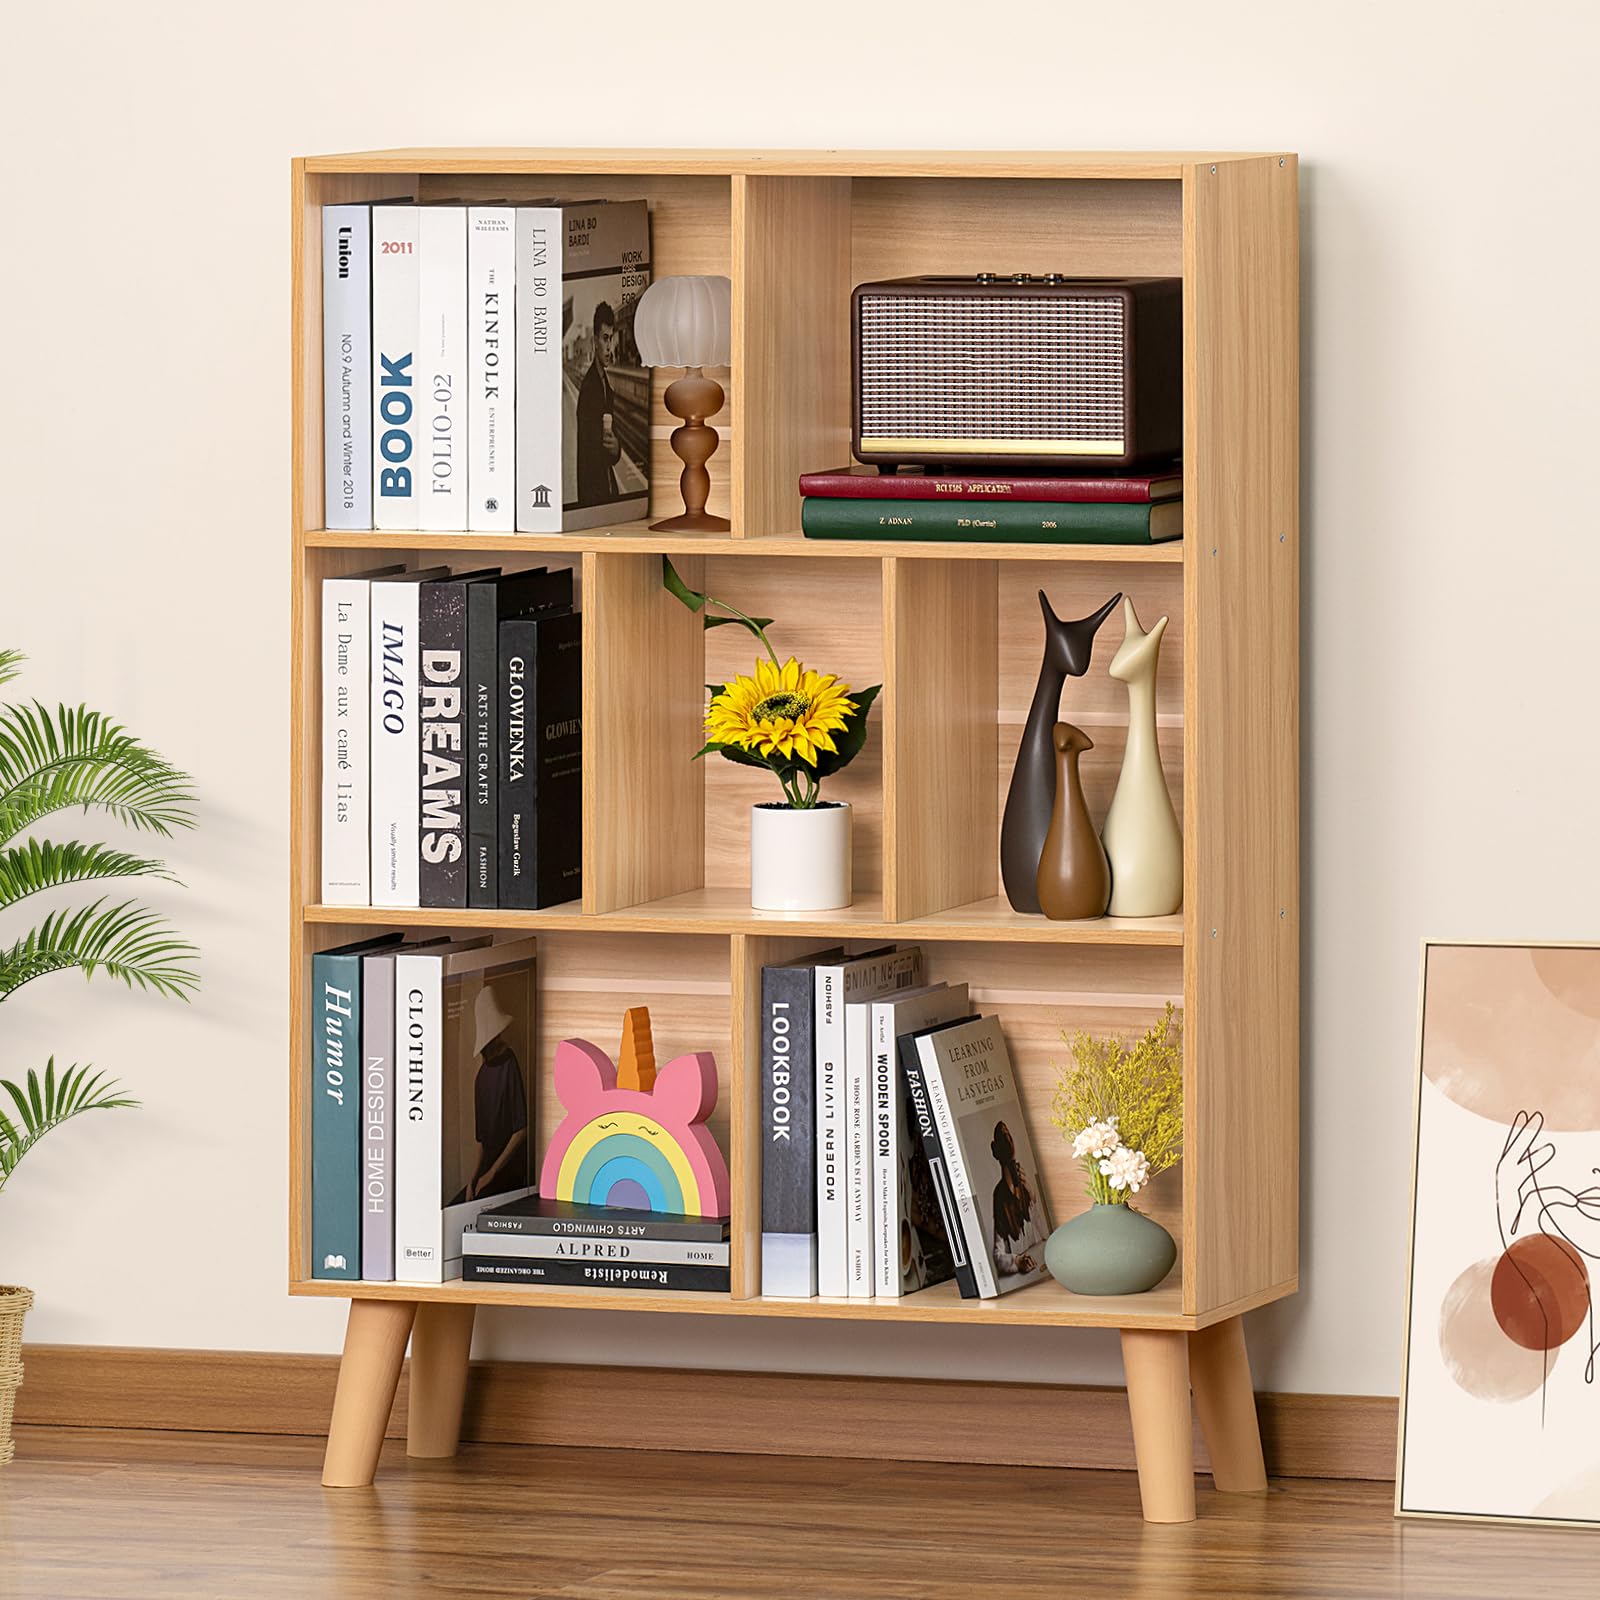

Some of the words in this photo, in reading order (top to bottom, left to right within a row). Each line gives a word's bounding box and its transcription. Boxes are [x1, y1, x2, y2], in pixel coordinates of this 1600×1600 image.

[569, 218, 586, 232] LINA
[587, 217, 597, 230] BO
[569, 233, 590, 248] BARDI
[338, 226, 352, 279] Union
[381, 241, 413, 254] 2011
[533, 228, 546, 267] LINA
[621, 250, 643, 264] WORK
[534, 277, 547, 297] BO
[621, 273, 647, 288] DESIGN
[341, 333, 352, 364] NO.9
[485, 292, 499, 399] KINFOLK
[534, 307, 547, 354] BARDI
[342, 366, 352, 412] Autumn
[342, 415, 352, 439] and
[380, 351, 413, 497] BOOK
[432, 374, 452, 495] FOLIO-02
[342, 440, 353, 476] Winter
[343, 479, 354, 509] 2018
[888, 517, 913, 525] ADNAN
[338, 602, 352, 622] La
[338, 634, 352, 675] Dame
[383, 620, 404, 734] IMAGO
[338, 686, 348, 717] aux
[478, 684, 488, 718] ARTS
[479, 722, 488, 748] THE
[421, 650, 462, 864] DREAMS
[478, 754, 489, 805] CRAFTS
[337, 783, 352, 823] lias
[479, 847, 487, 888] FASHION
[325, 982, 352, 1106] Humor
[408, 989, 424, 1122] CLOTHING
[949, 1036, 994, 1063] LEARNING
[772, 1002, 790, 1142] LOOKBOOK
[877, 1054, 888, 1109] WOODEN
[963, 1059, 990, 1079] FROM
[825, 1062, 834, 1120] LIVING
[906, 1069, 934, 1138] FASHION
[878, 1113, 890, 1157] SPOON
[931, 1079, 949, 1128] LEARNING
[943, 1130, 957, 1158] FROM
[951, 1160, 961, 1179] LAS
[958, 1182, 969, 1213] VEGAS
[368, 1148, 385, 1213] HOME
[826, 1128, 835, 1201] MODERN
[487, 1221, 522, 1230] FASHION
[617, 1225, 646, 1236] ARTS
[406, 1248, 432, 1258] Better
[687, 1252, 714, 1260] HOME
[584, 1267, 668, 1284] Remodelista
